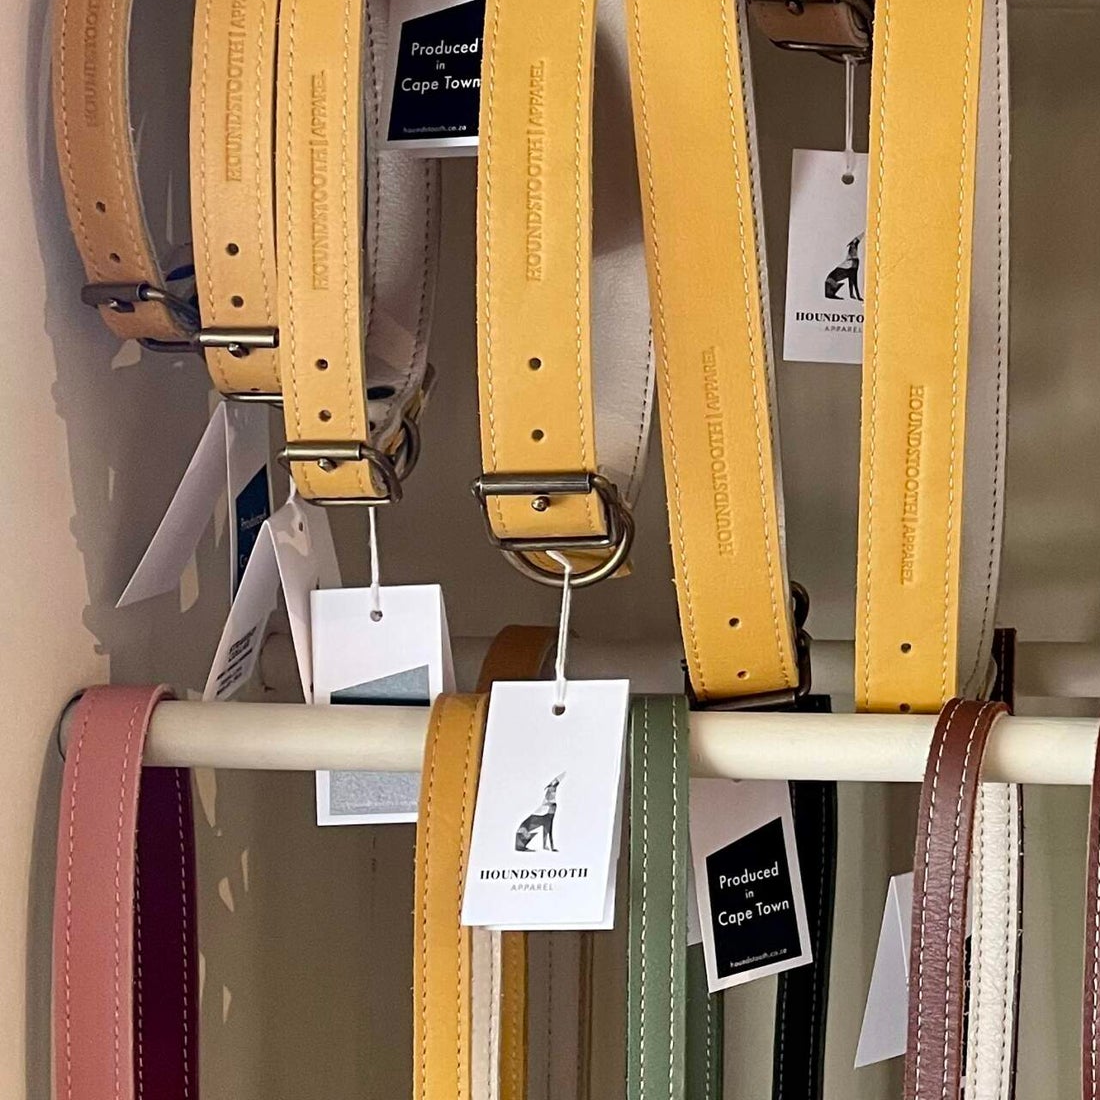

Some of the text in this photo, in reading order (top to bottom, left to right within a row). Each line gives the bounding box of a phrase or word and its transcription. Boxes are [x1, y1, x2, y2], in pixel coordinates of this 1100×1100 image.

[411, 37, 479, 56] Produced
[436, 60, 445, 70] in
[401, 76, 481, 95] Cape Town
[796, 312, 864, 323] HOUNDSTO
[479, 868, 588, 880] HOUNDSTOOTH
[719, 861, 779, 890] Produced
[745, 889, 754, 899] in
[718, 900, 790, 926] Cape Town
